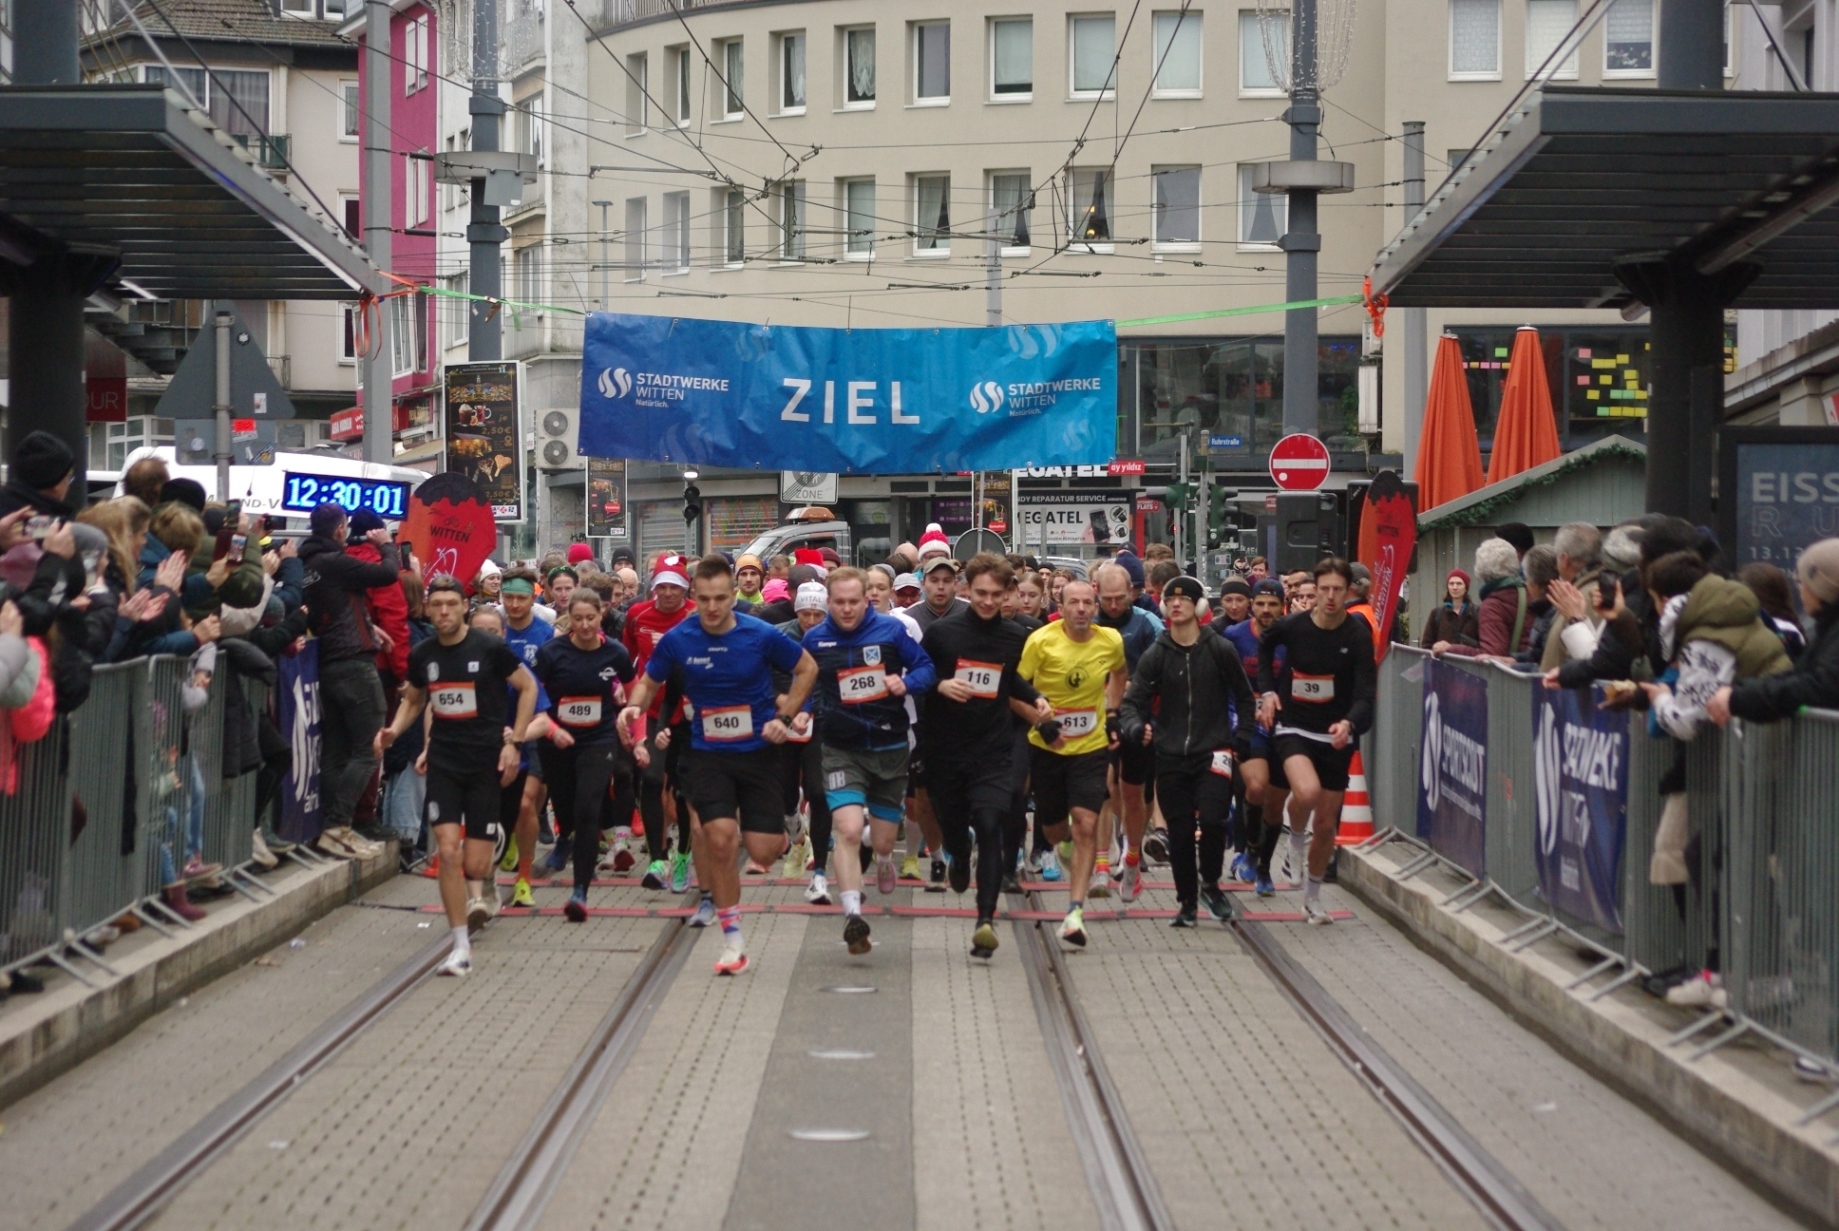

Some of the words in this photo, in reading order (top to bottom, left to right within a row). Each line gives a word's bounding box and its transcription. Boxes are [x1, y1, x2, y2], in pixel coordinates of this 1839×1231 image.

[636, 373, 730, 392] STADTWERKE
[1008, 377, 1101, 396] STADTWERKE
[635, 386, 685, 401] WITTEN
[635, 399, 669, 408] Natürlich.
[780, 377, 920, 425] ZIEL
[1008, 394, 1056, 409] WITTEN
[1009, 408, 1042, 417] Natürlich.
[481, 426, 512, 435] 2,50€
[1211, 438, 1240, 446] Ruhrstraße
[1111, 464, 1120, 473] ay
[796, 489, 823, 499] ZONE
[1752, 472, 1839, 503] EISS
[286, 477, 404, 515] 12:30:01
[1031, 495, 1075, 503] REPARATUR
[1076, 494, 1107, 502] SERVICE
[1018, 511, 1083, 524] EGATEL
[430, 525, 470, 543] WITTEN
[850, 676, 876, 690] 268
[967, 671, 990, 685] 116
[1304, 682, 1320, 693] 39
[439, 693, 464, 705] 654
[568, 704, 591, 716] 489
[714, 716, 740, 729] 640
[1064, 716, 1087, 728] 613
